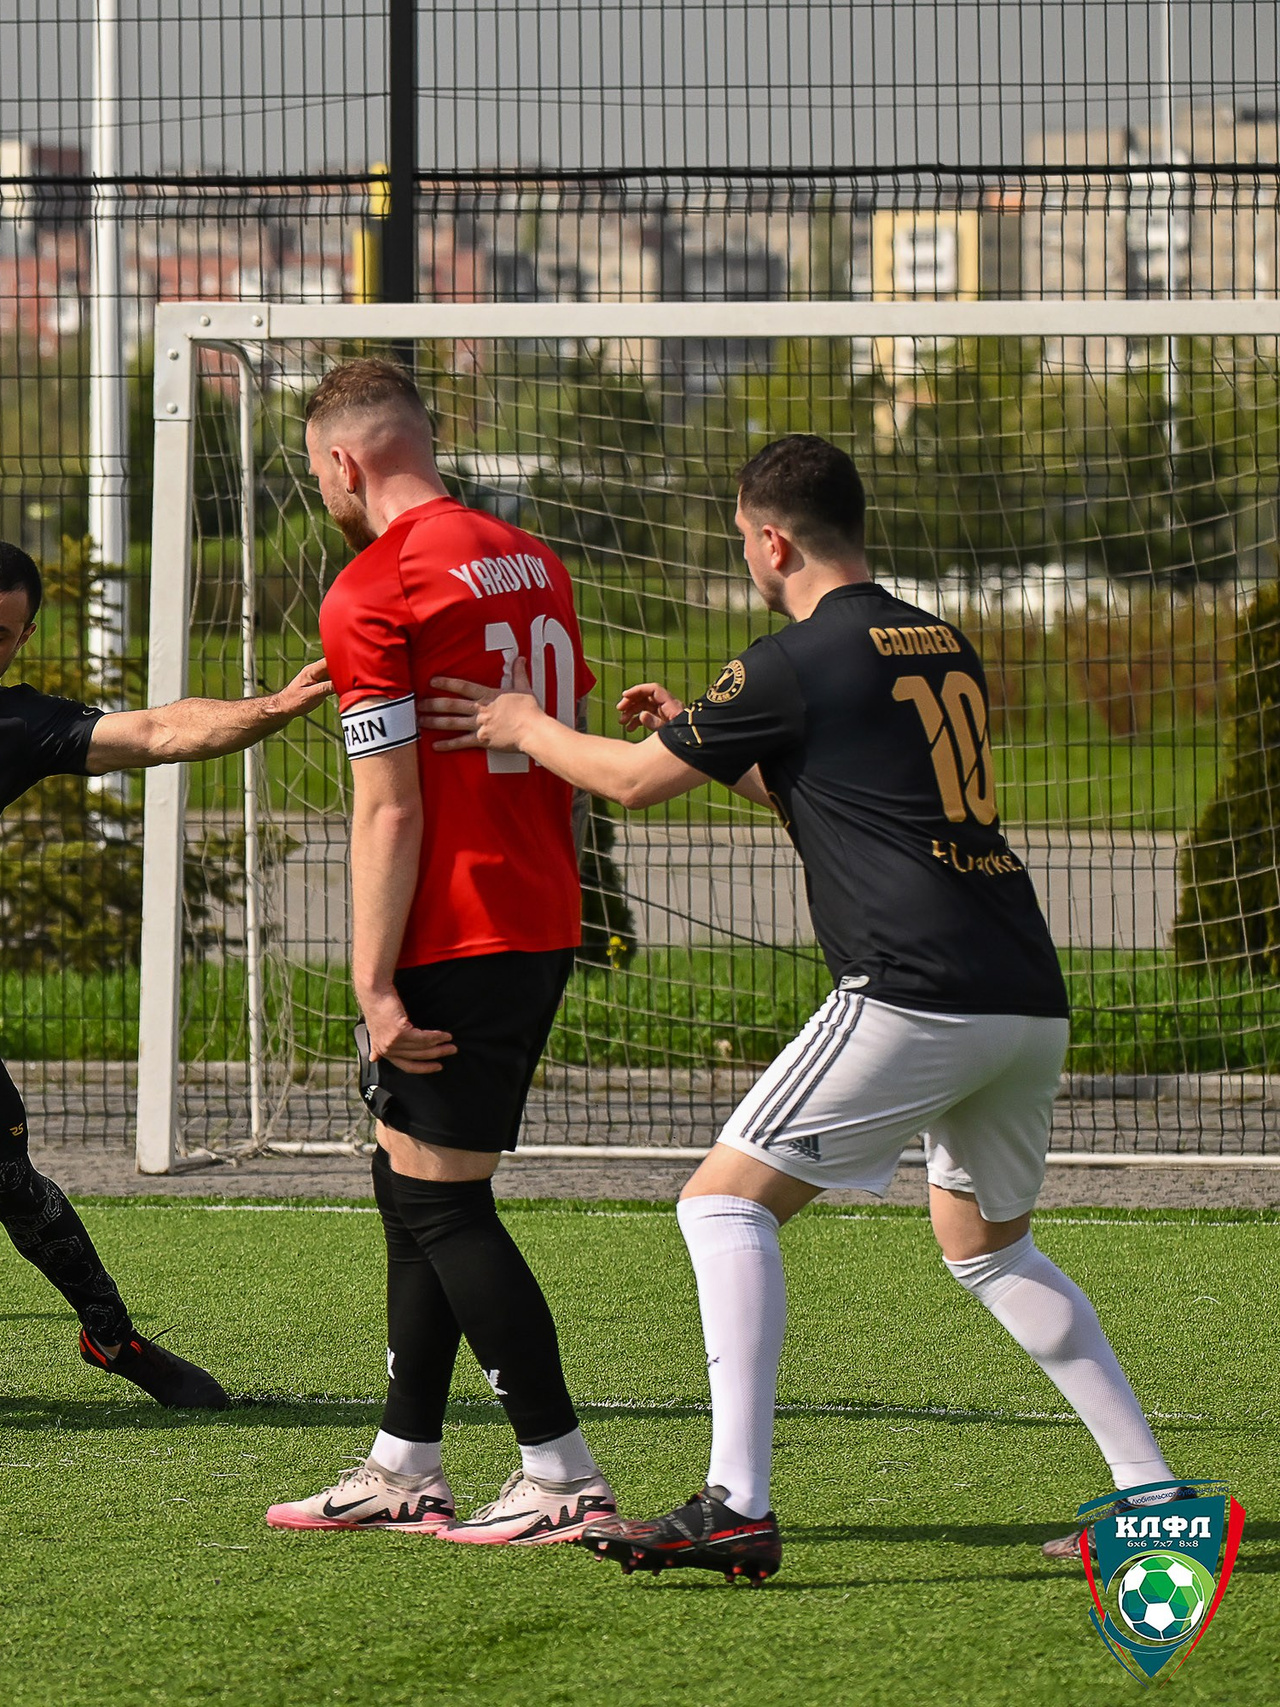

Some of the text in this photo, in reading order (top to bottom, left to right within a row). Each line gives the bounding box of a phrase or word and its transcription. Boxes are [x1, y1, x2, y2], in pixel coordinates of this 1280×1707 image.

[448, 553, 555, 599] YAROVOY
[869, 625, 961, 656] САЛАЕВ
[485, 614, 576, 774] 10
[891, 671, 998, 825] 10
